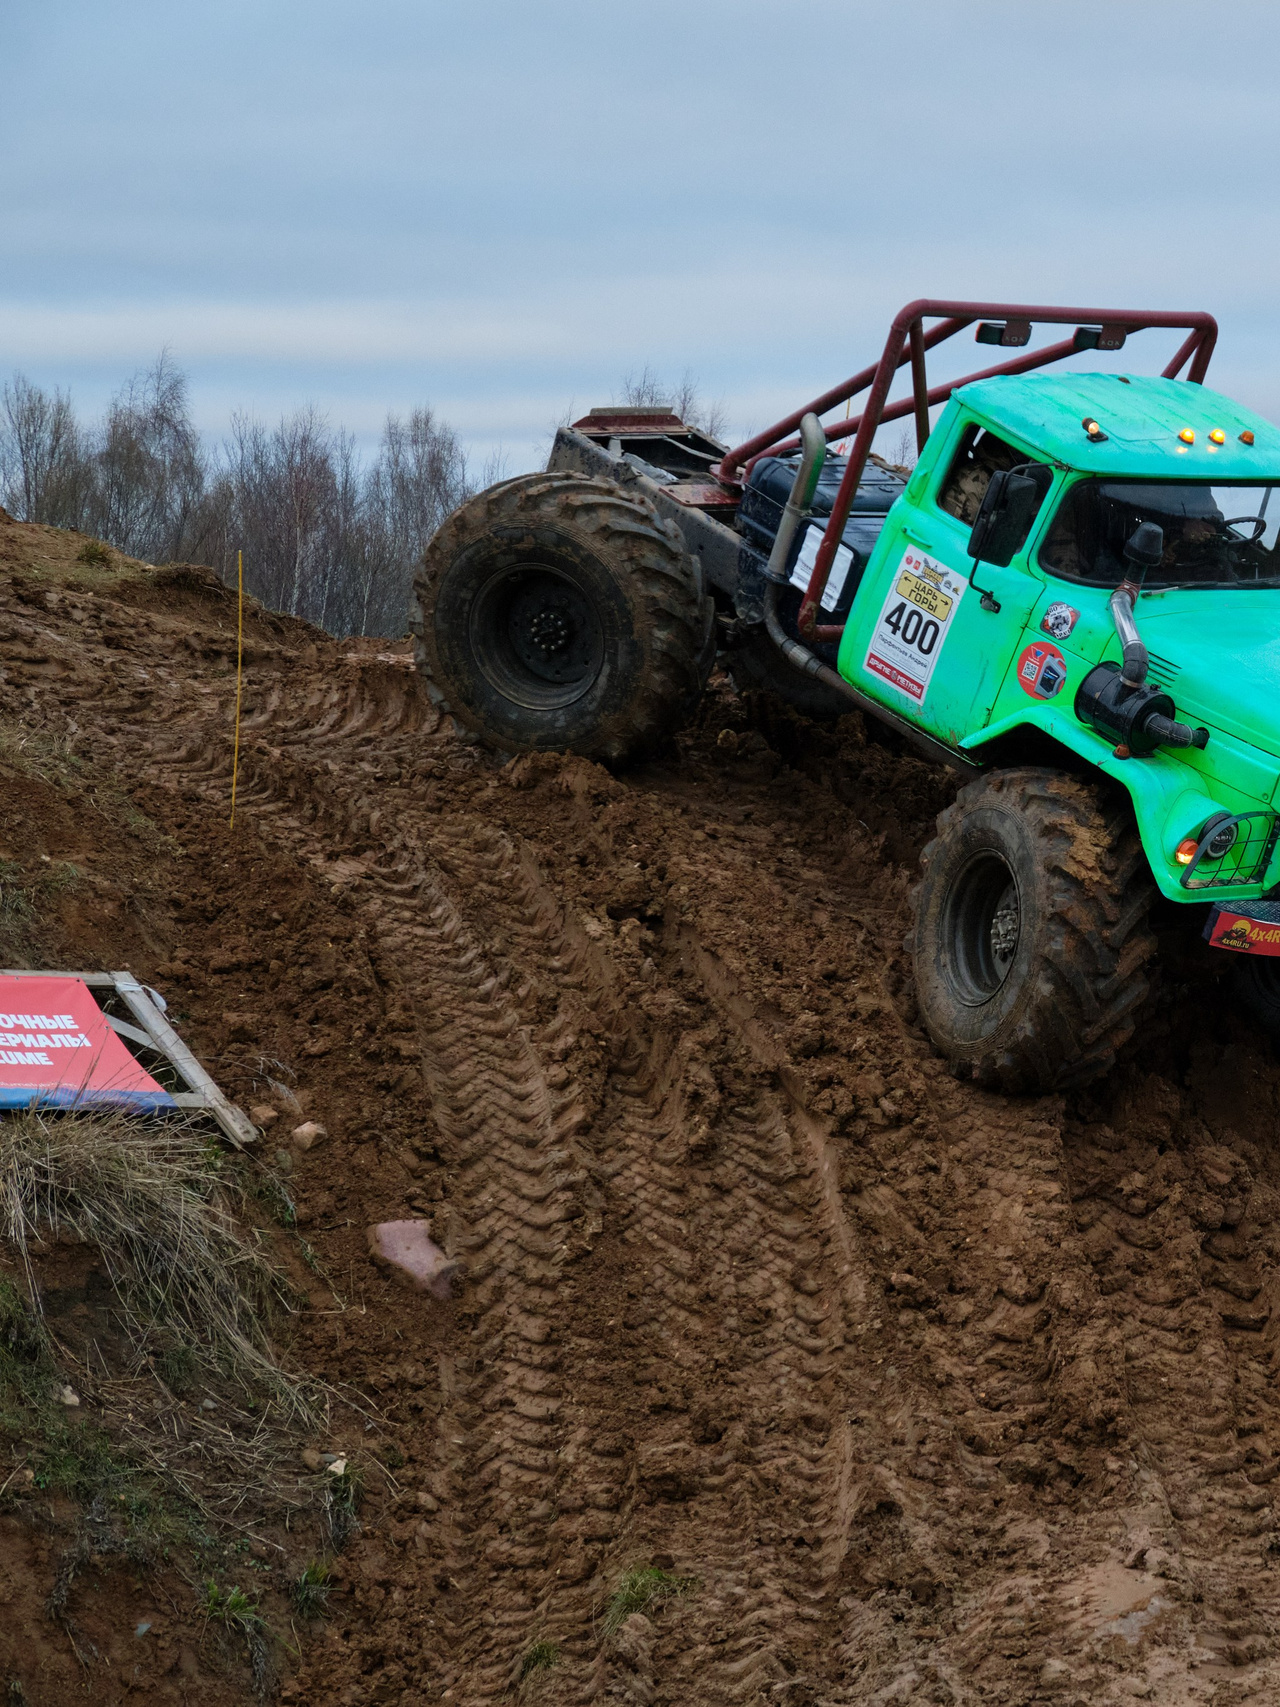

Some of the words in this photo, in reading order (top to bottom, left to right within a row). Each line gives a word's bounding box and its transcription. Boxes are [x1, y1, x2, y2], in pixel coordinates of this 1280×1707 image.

[908, 589, 938, 613] ГОРЫ
[914, 581, 938, 601] ЦАРЬ
[885, 601, 940, 655] 400
[0, 1013, 79, 1029] ОЧНЫЕ
